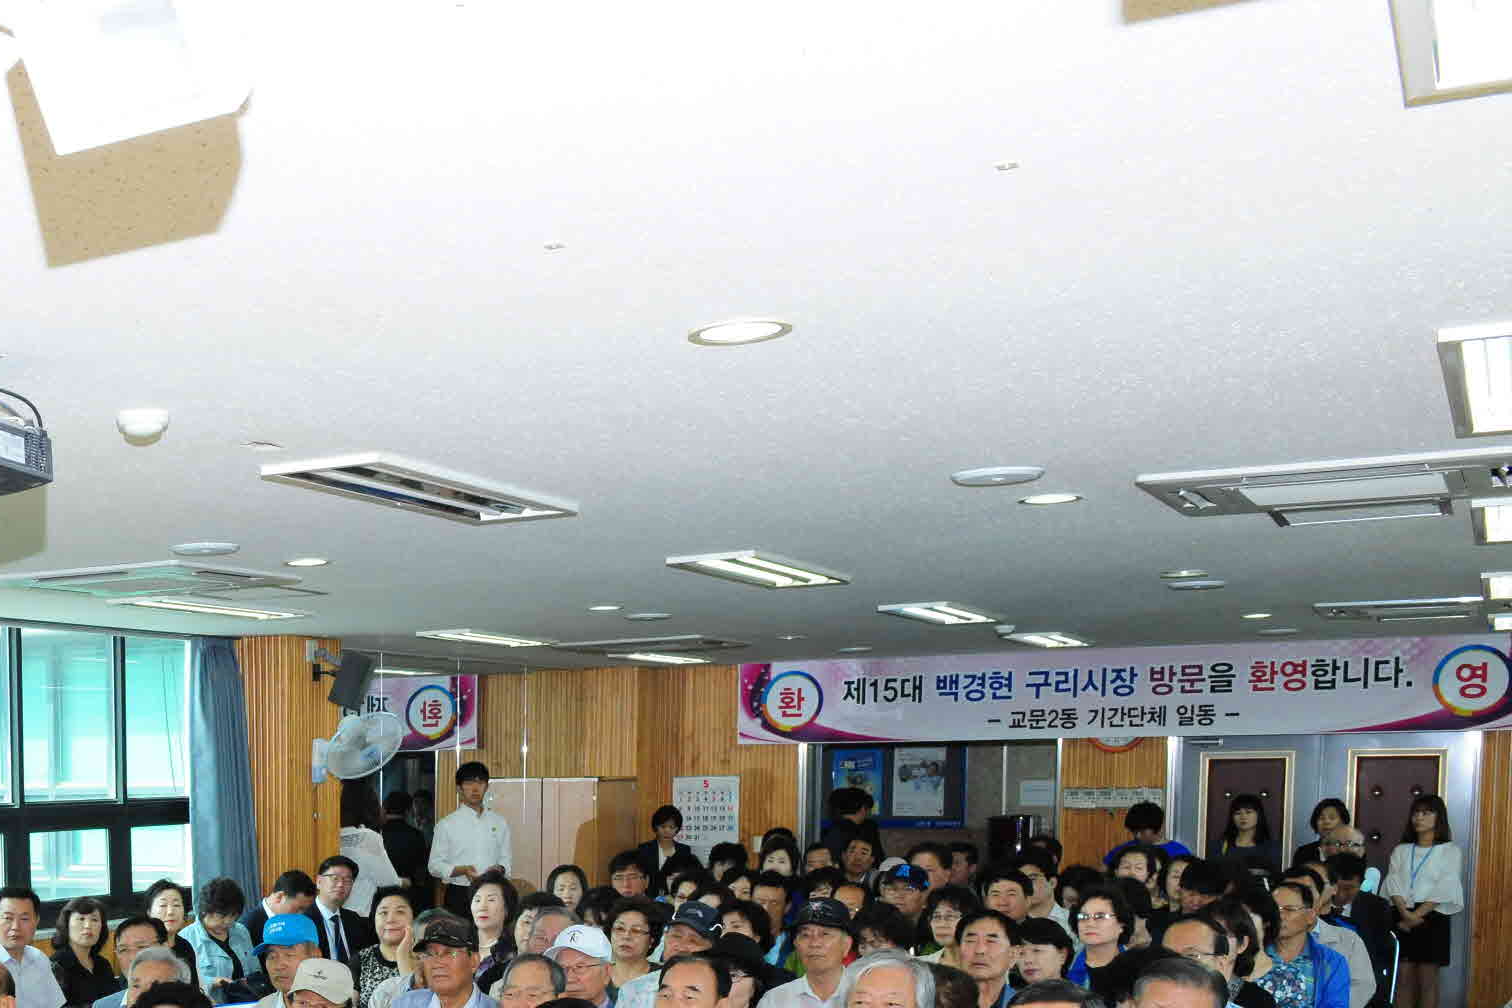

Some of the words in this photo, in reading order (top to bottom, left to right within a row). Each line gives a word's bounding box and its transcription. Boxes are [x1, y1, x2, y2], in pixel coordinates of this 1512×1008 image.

[843, 674, 923, 705] 제15대
[935, 671, 1014, 702] 백경현
[1024, 665, 1138, 699] 구리시장
[1148, 661, 1237, 697] 방문을
[1248, 656, 1414, 692] 환영합니다.
[1455, 661, 1489, 700] 영
[778, 687, 805, 718] 환
[1008, 707, 1079, 730] 교문2동
[1087, 704, 1167, 729] 기간단체
[1176, 704, 1216, 727] 일동
